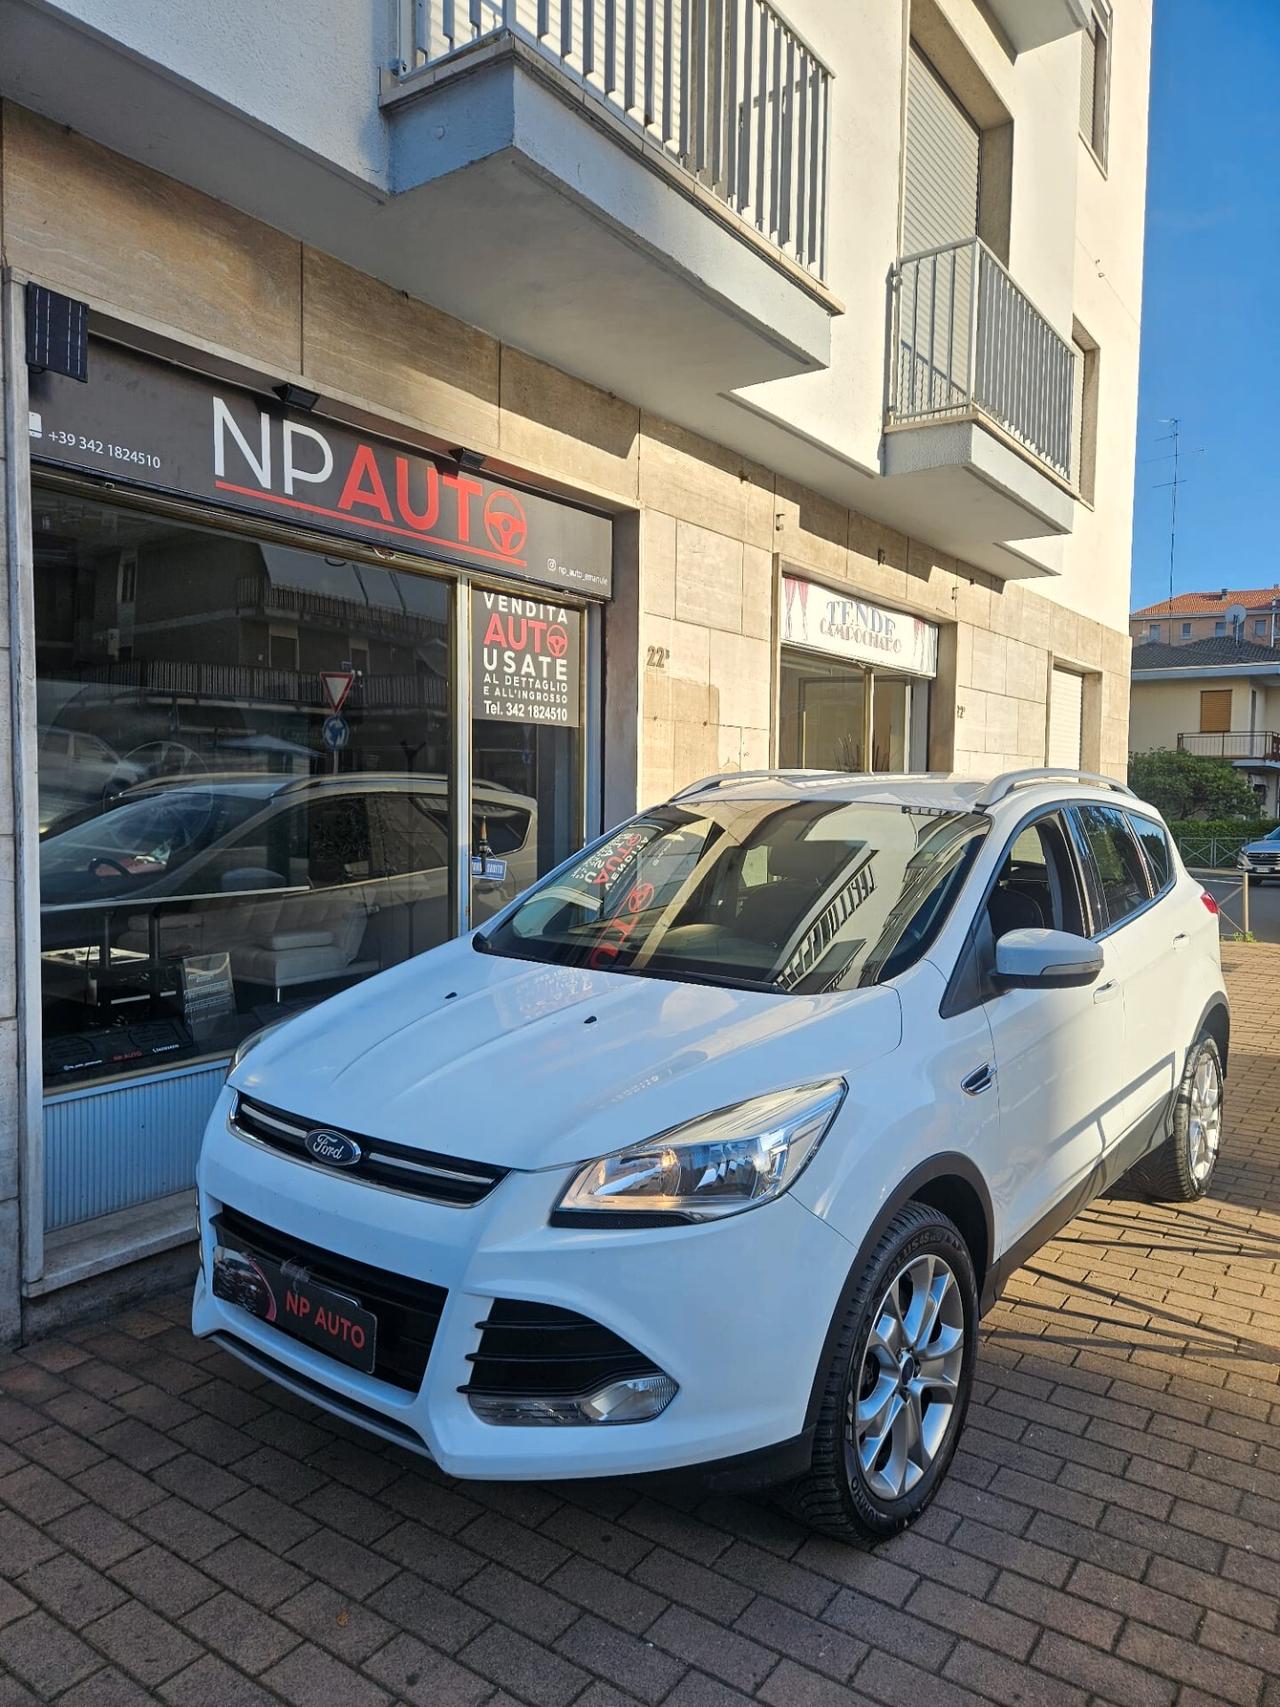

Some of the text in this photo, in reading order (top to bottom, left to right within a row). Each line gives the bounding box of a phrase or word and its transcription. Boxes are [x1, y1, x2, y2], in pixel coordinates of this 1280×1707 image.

[48, 431, 161, 469] +39 342 1824510
[213, 396, 334, 495] NP
[483, 591, 568, 624] VENDITA
[826, 600, 896, 636] TENDE
[483, 647, 568, 681] USATE
[483, 673, 568, 693] AL DETTAGLIO
[483, 686, 568, 704] E ALL'INGROSSO
[484, 700, 568, 721] Tel. 342 1824510
[313, 1134, 344, 1159] Ford
[286, 1289, 366, 1350] NP AUTO
